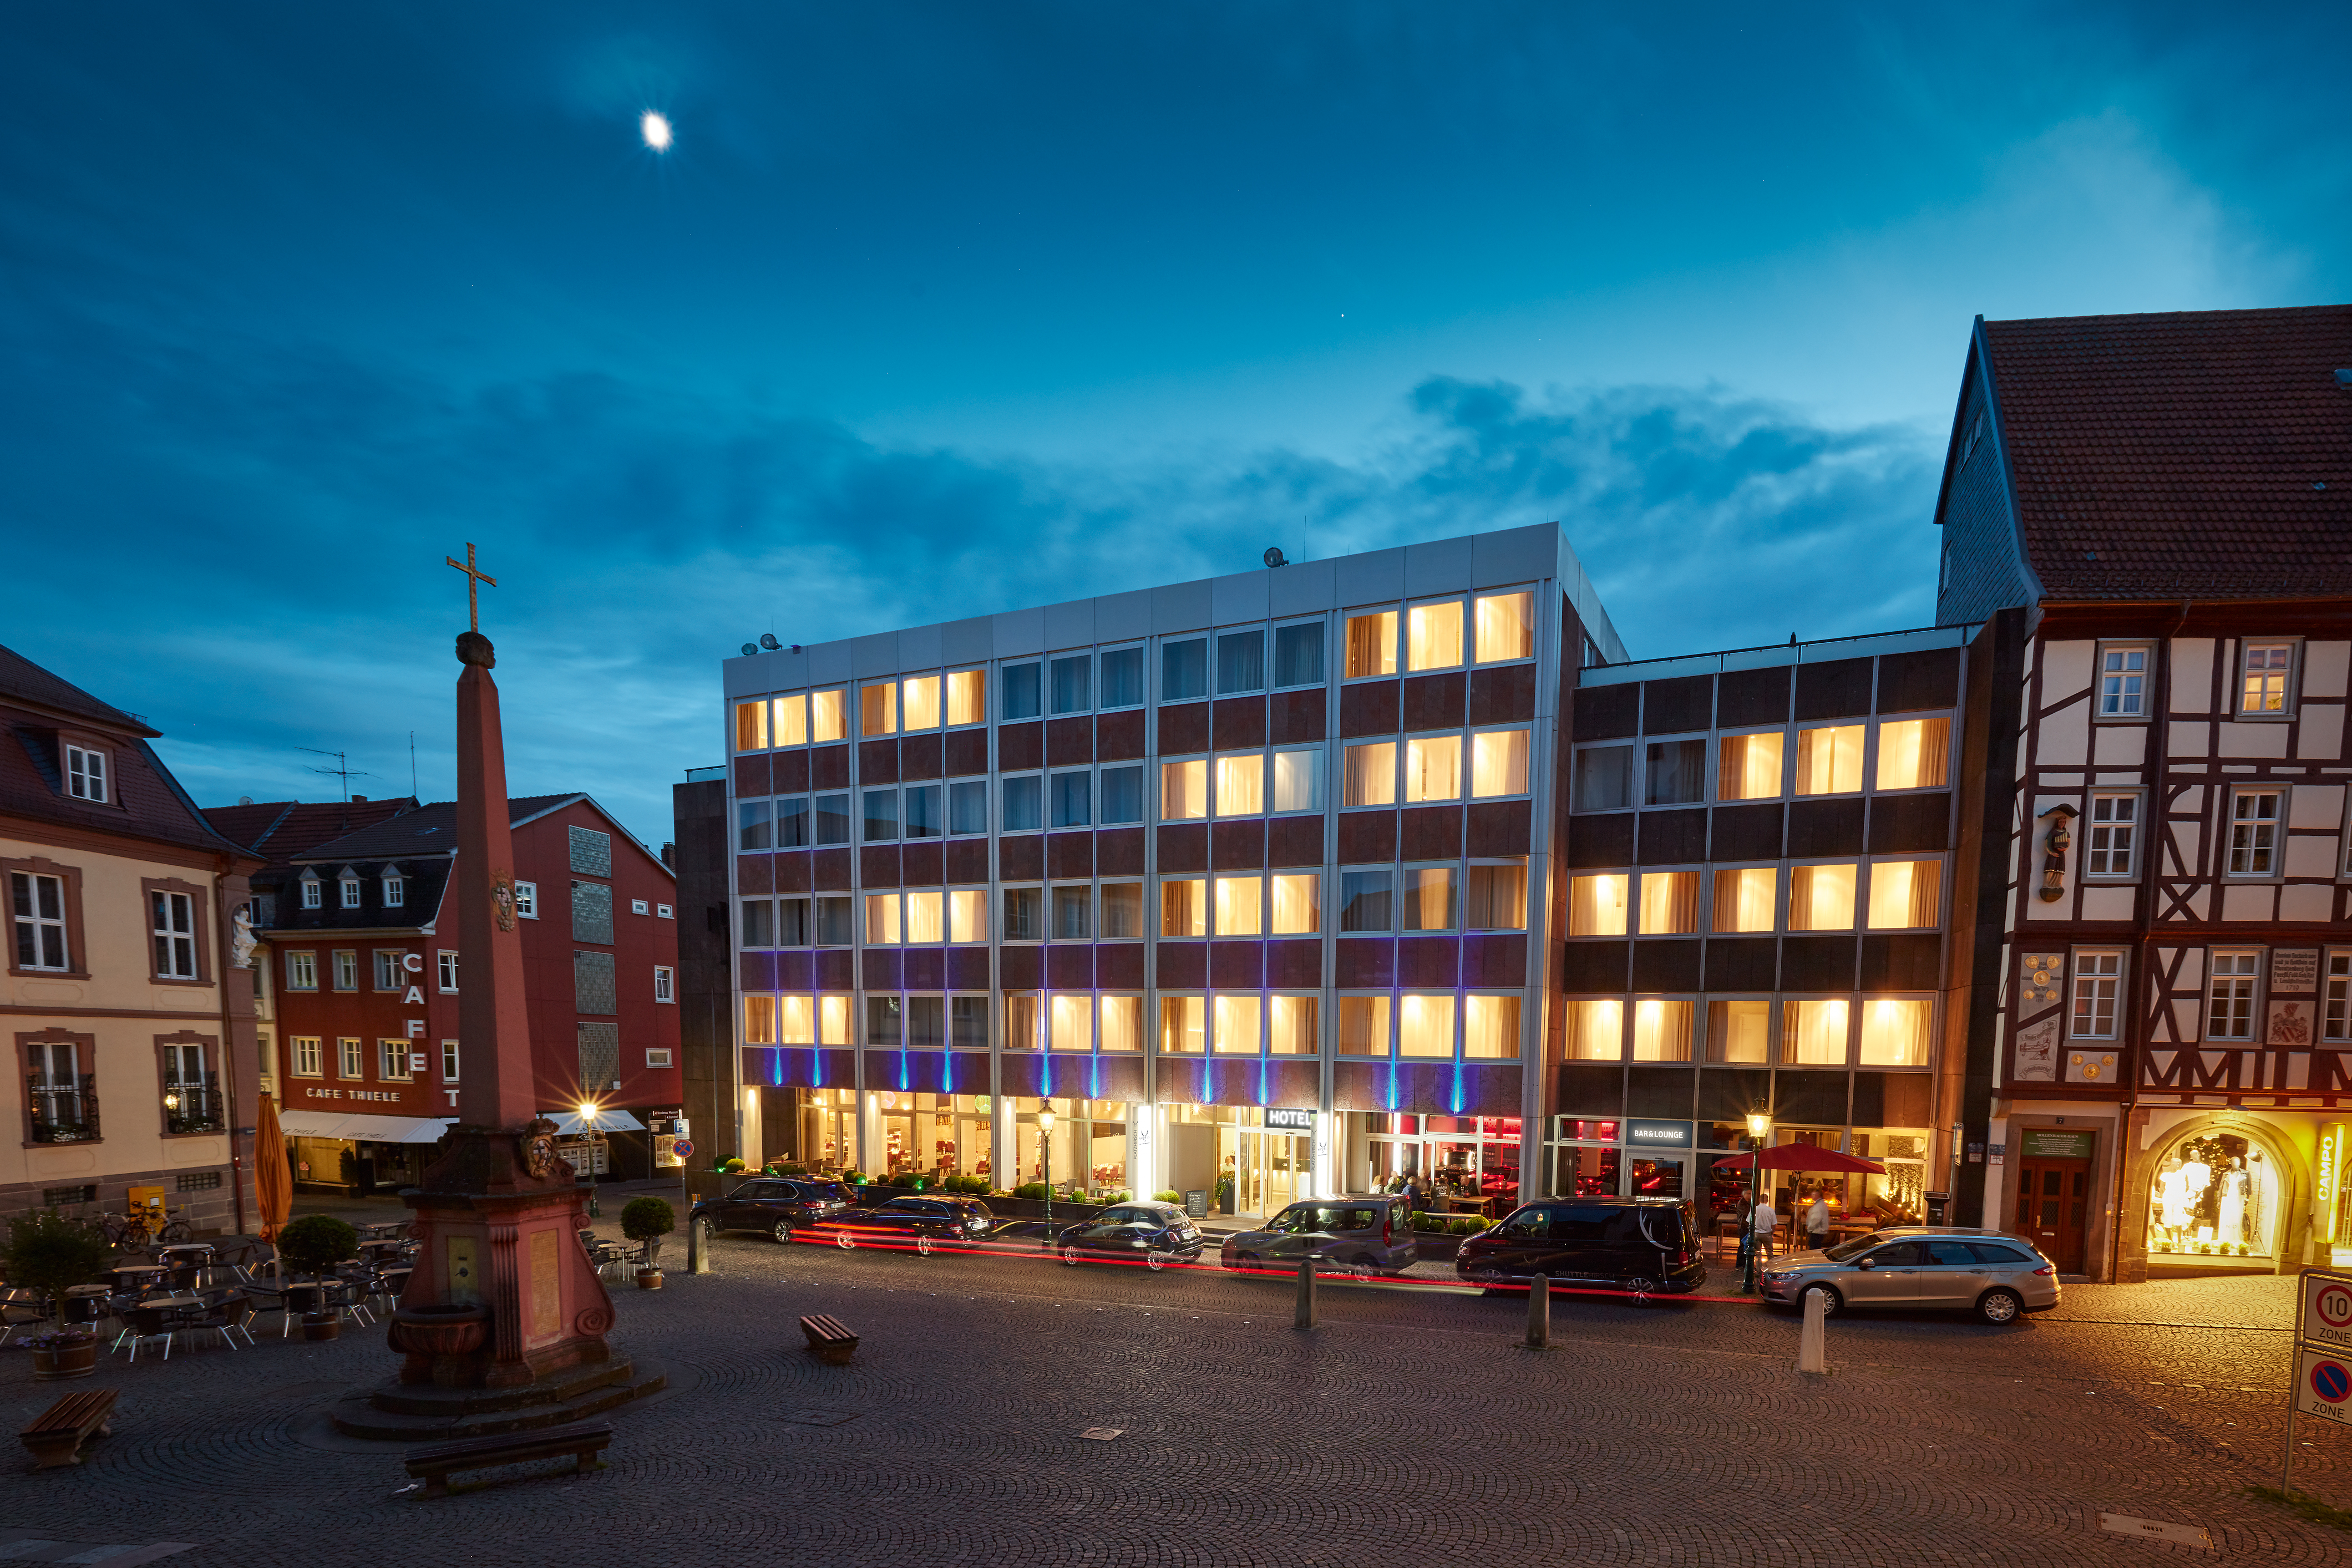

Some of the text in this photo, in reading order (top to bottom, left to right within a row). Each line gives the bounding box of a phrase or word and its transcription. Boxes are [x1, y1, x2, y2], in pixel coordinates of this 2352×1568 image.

[402, 953, 425, 1071] CAFE
[306, 1088, 401, 1102] CAFE THIELE
[1270, 1110, 1311, 1125] HOTEL
[2318, 1136, 2333, 1200] CAMPO
[2326, 1296, 2347, 1316] 10
[2319, 1327, 2351, 1343] ZONE
[2312, 1401, 2345, 1419] ZONE
